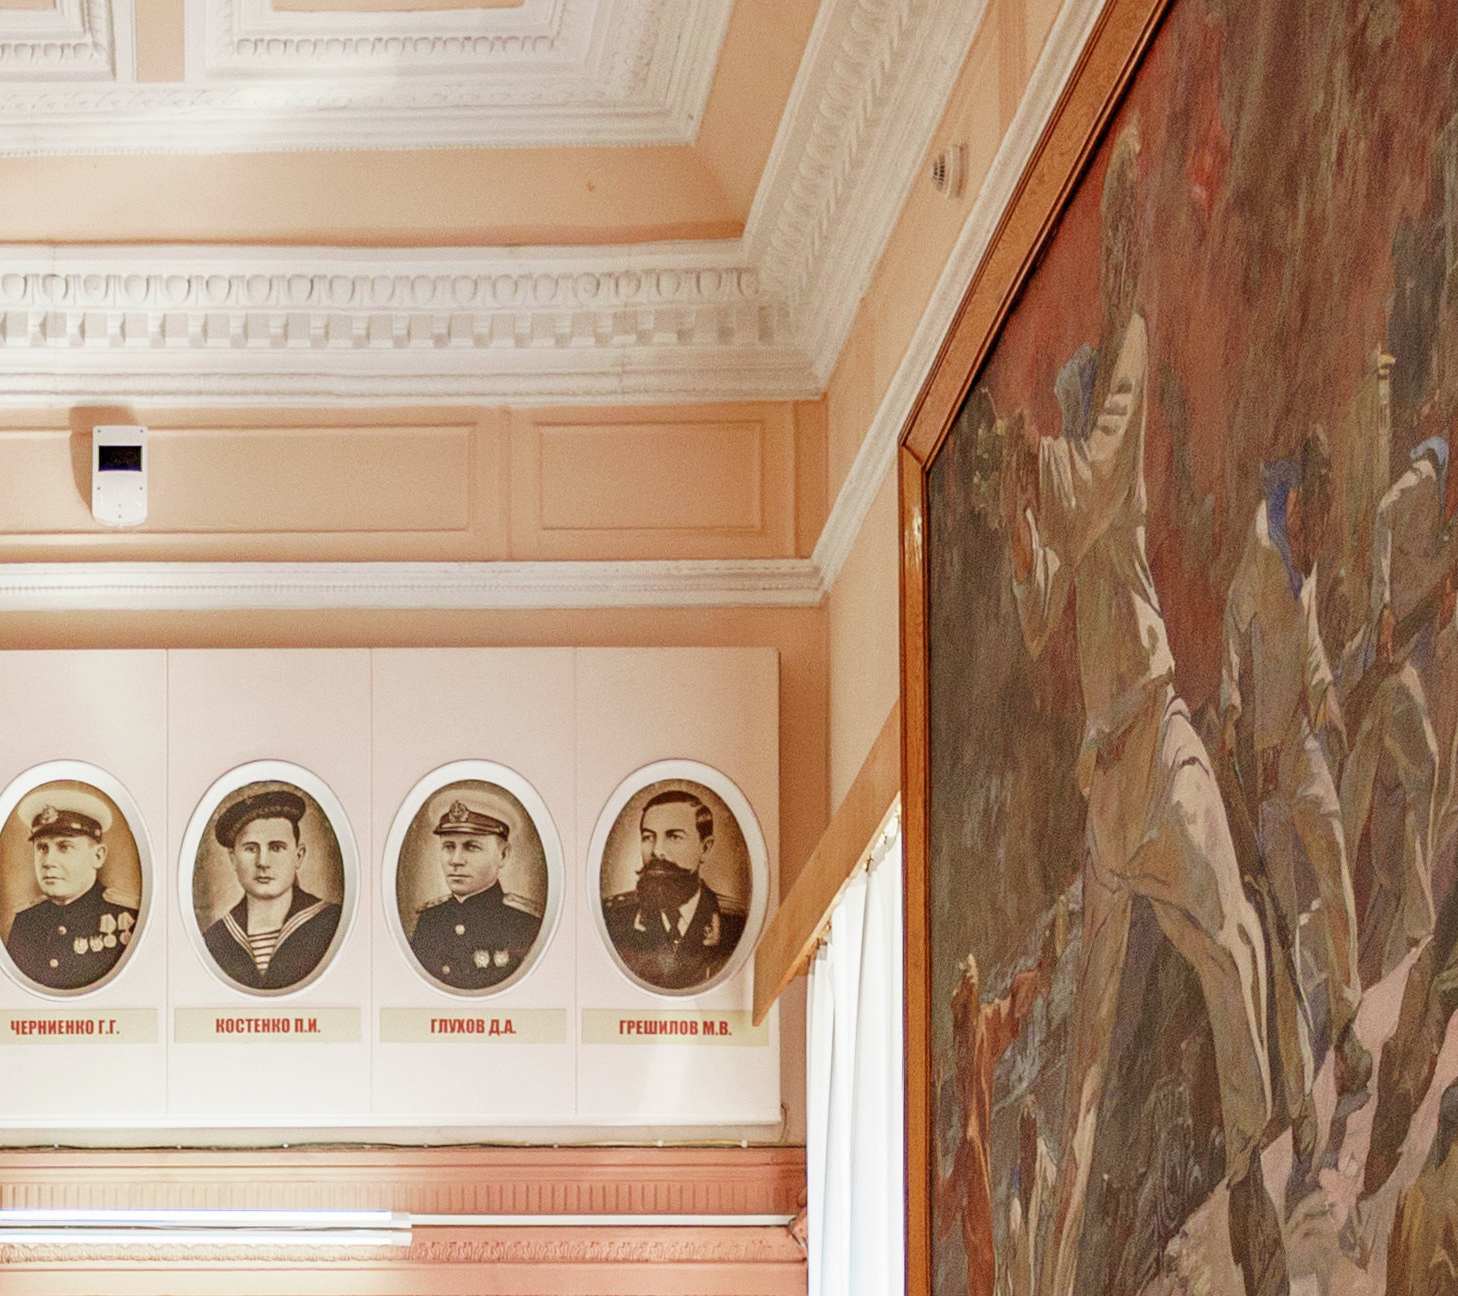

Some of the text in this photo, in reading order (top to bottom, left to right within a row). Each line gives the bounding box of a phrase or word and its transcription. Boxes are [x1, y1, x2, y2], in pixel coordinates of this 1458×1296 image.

[10, 1019, 121, 1036] ЧЕРНИЕНКО Г.Г.
[215, 1017, 322, 1034] КОСТЕНКО П.И.
[430, 1018, 517, 1037] ГЛУХОВ Д.А.
[618, 1019, 733, 1037] ГРЕШИЛОВ М.В.
